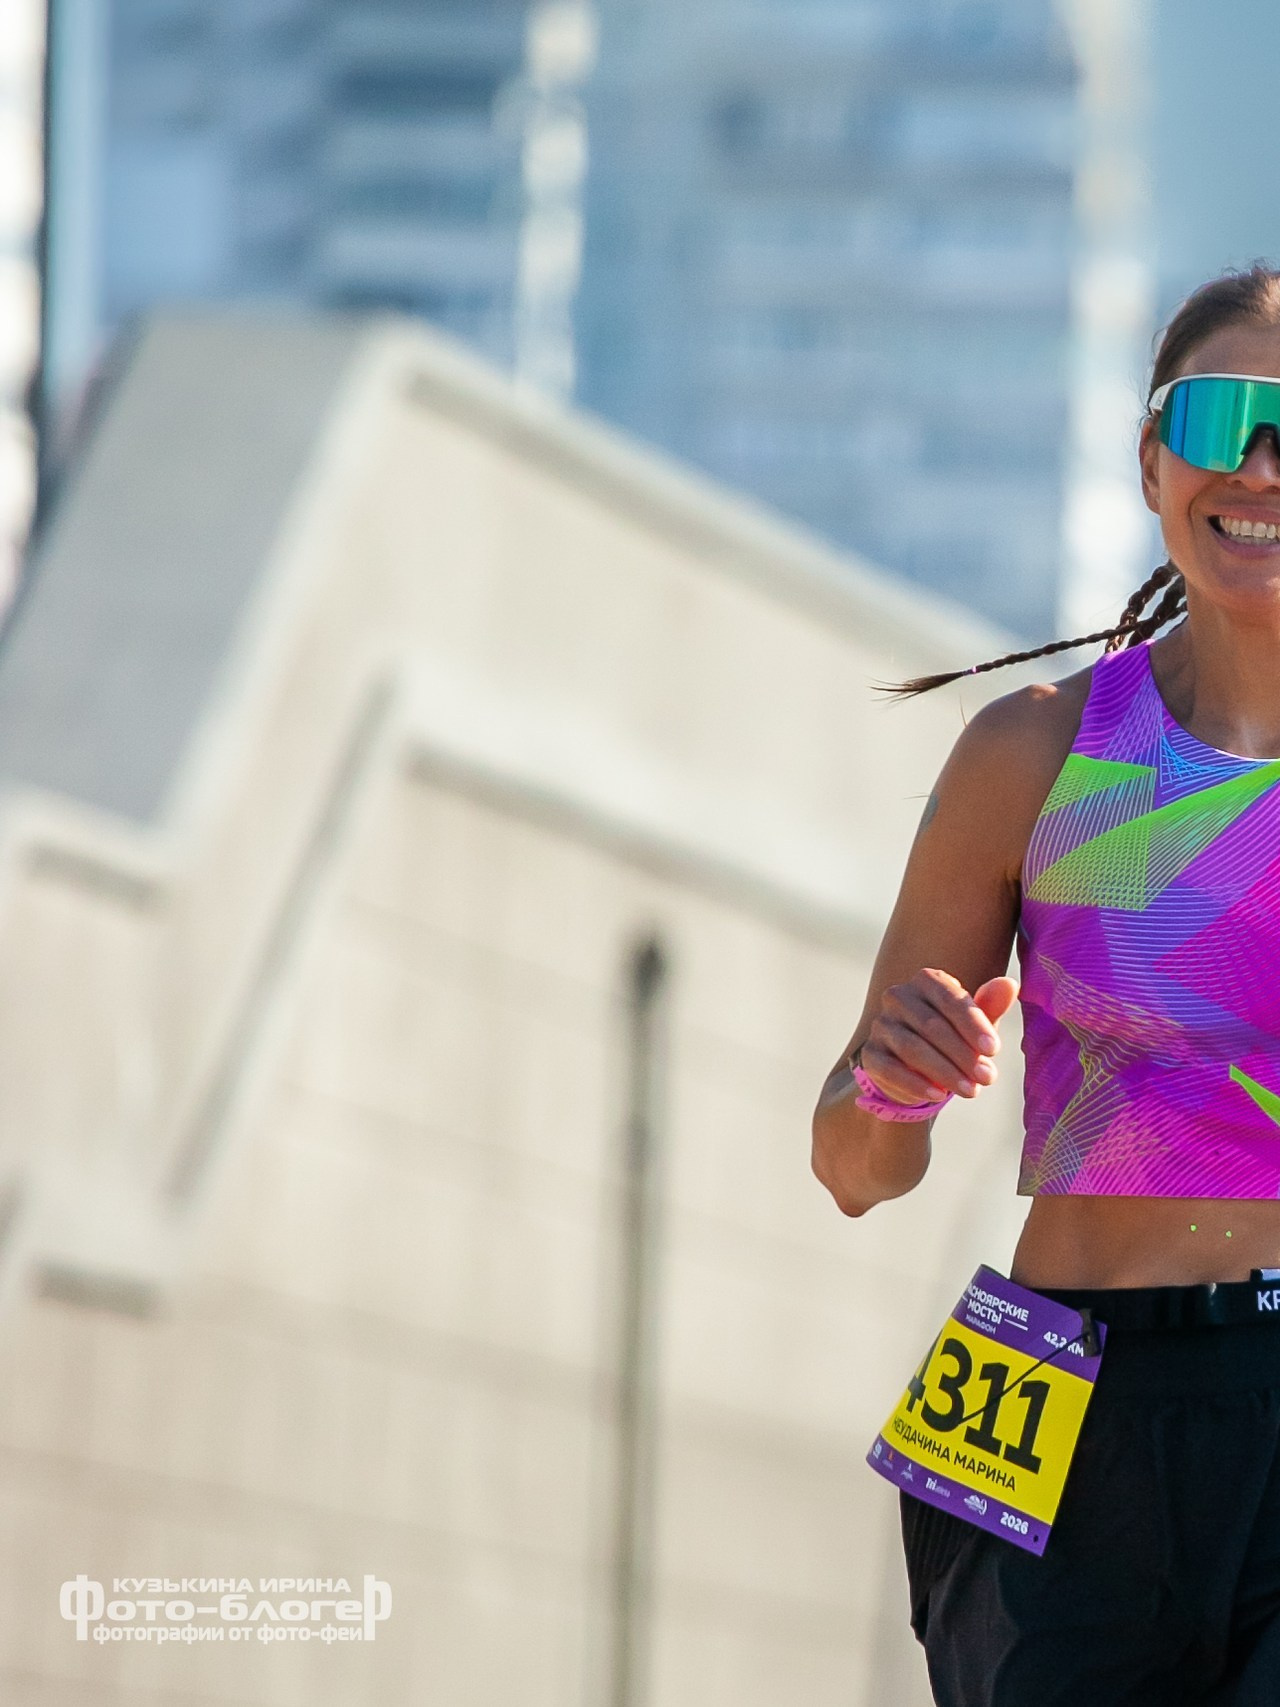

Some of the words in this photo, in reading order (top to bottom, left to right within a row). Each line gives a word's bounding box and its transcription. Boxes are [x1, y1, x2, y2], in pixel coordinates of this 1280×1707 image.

[967, 1298, 1002, 1325] МОСТЫ
[893, 1416, 951, 1460] НЕУДАЧИНА
[954, 1452, 1016, 1493] МАРИНА
[1000, 1511, 1029, 1535] 2026
